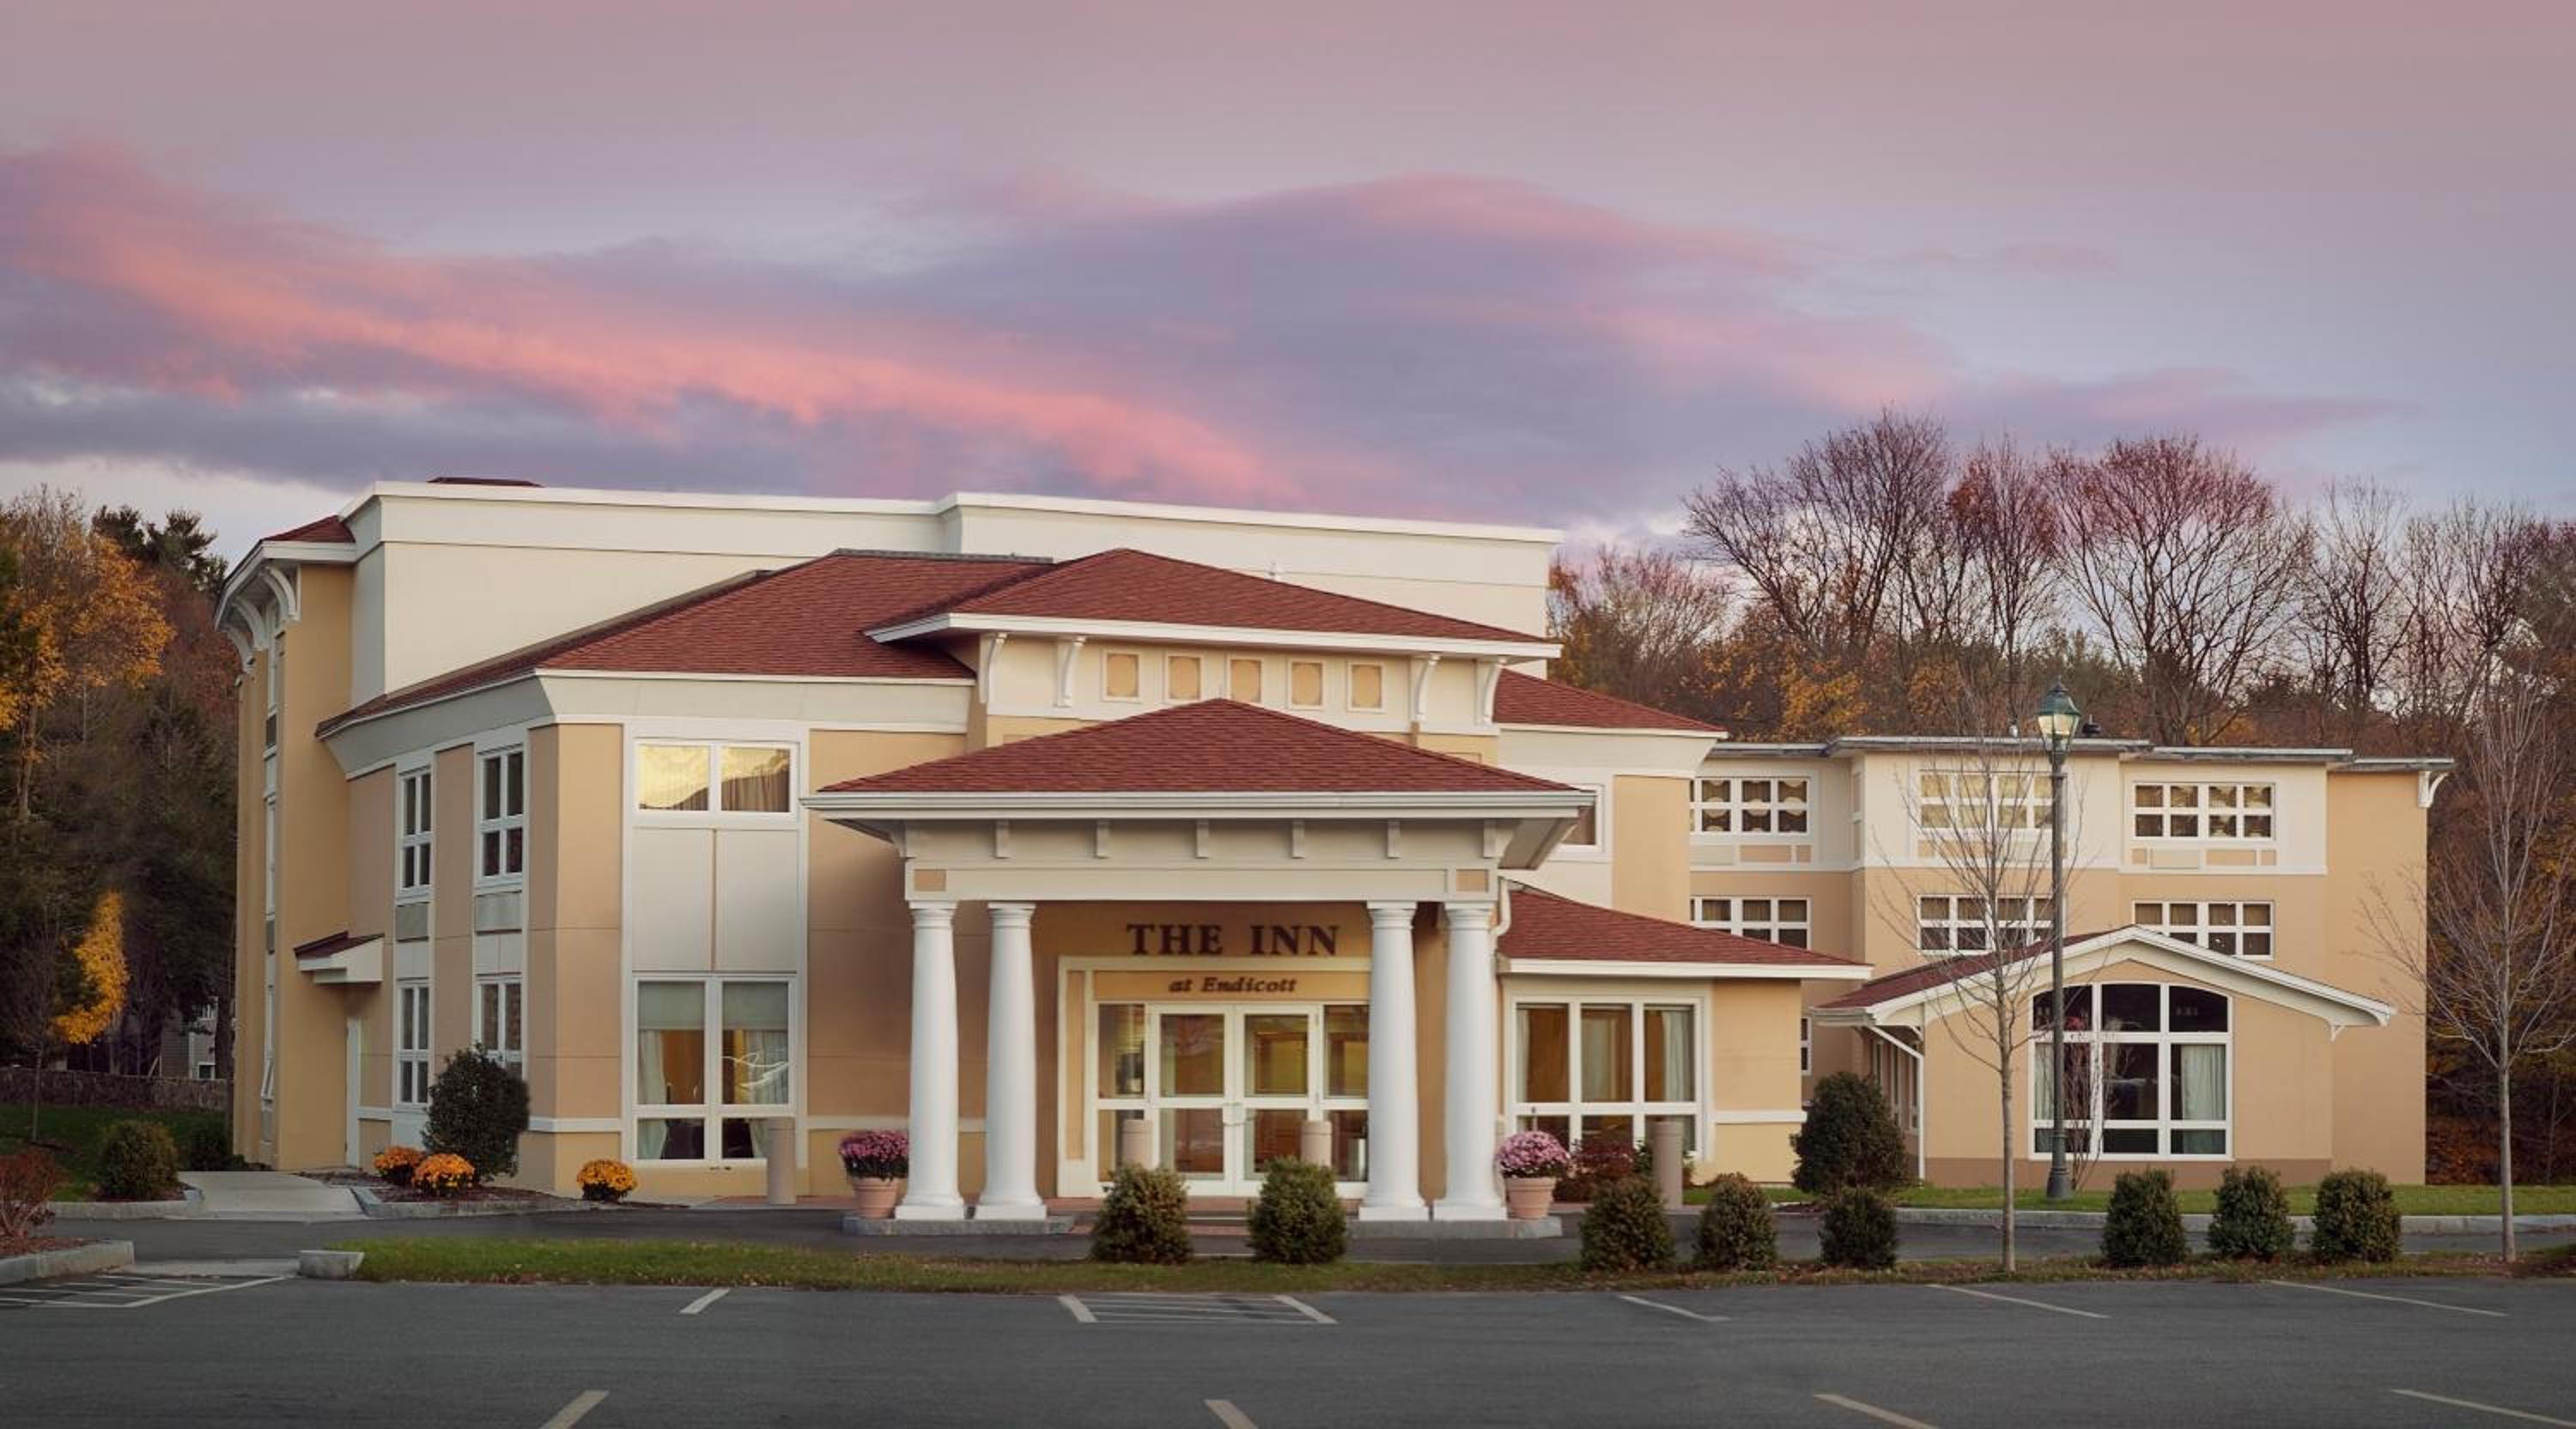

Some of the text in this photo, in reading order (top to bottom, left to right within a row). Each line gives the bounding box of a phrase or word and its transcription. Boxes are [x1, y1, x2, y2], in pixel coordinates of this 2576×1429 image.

[1126, 923, 1340, 956] THE INN
[1169, 976, 1297, 993] at Endicott
